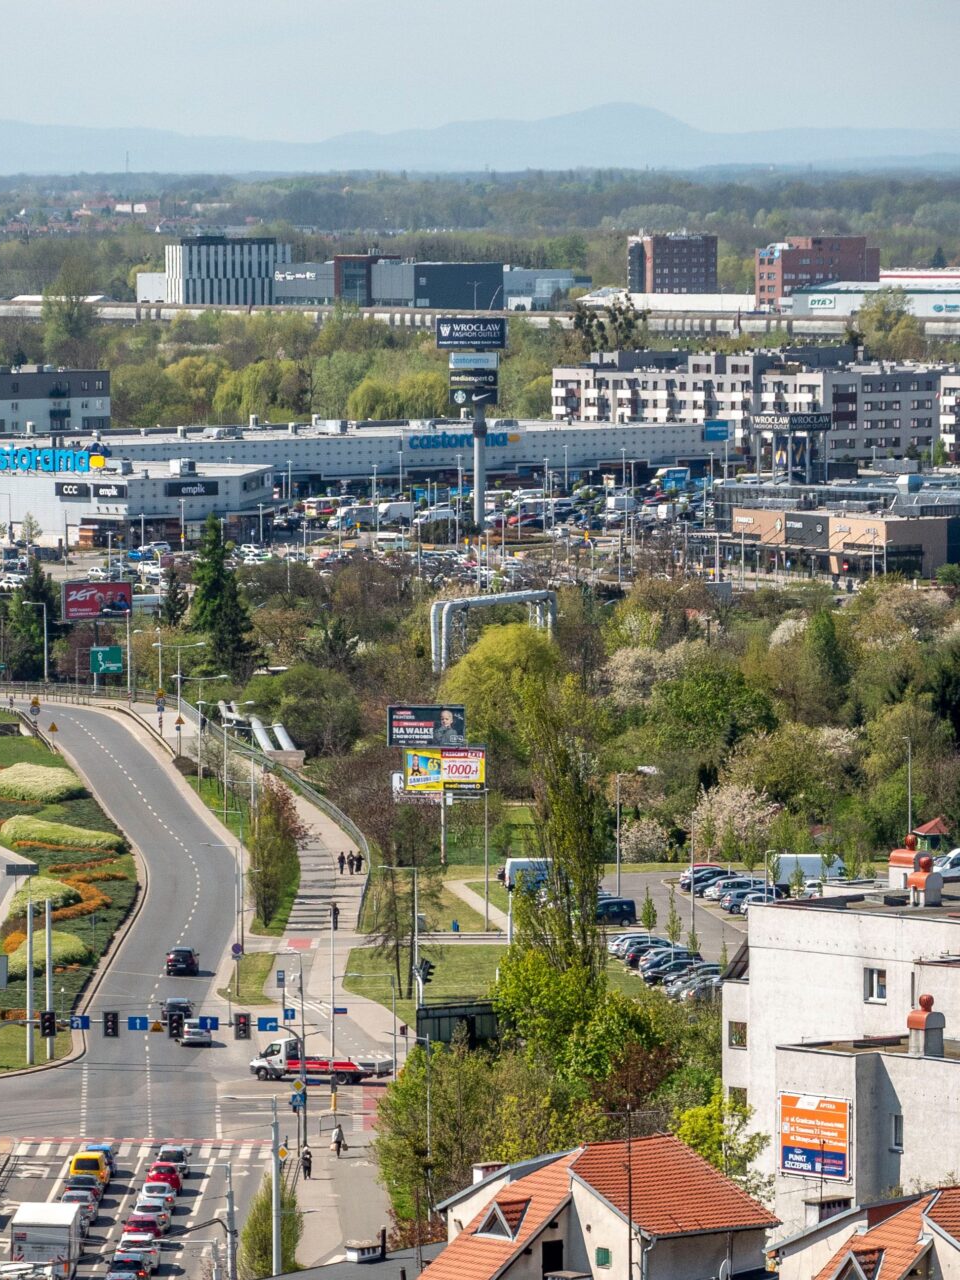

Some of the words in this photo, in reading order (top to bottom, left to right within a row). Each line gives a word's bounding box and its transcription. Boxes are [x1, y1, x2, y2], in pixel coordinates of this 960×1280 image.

[62, 485, 78, 495] CCC
[98, 484, 118, 497] empik
[181, 483, 205, 495] empik
[788, 1153, 807, 1162] PUNKT
